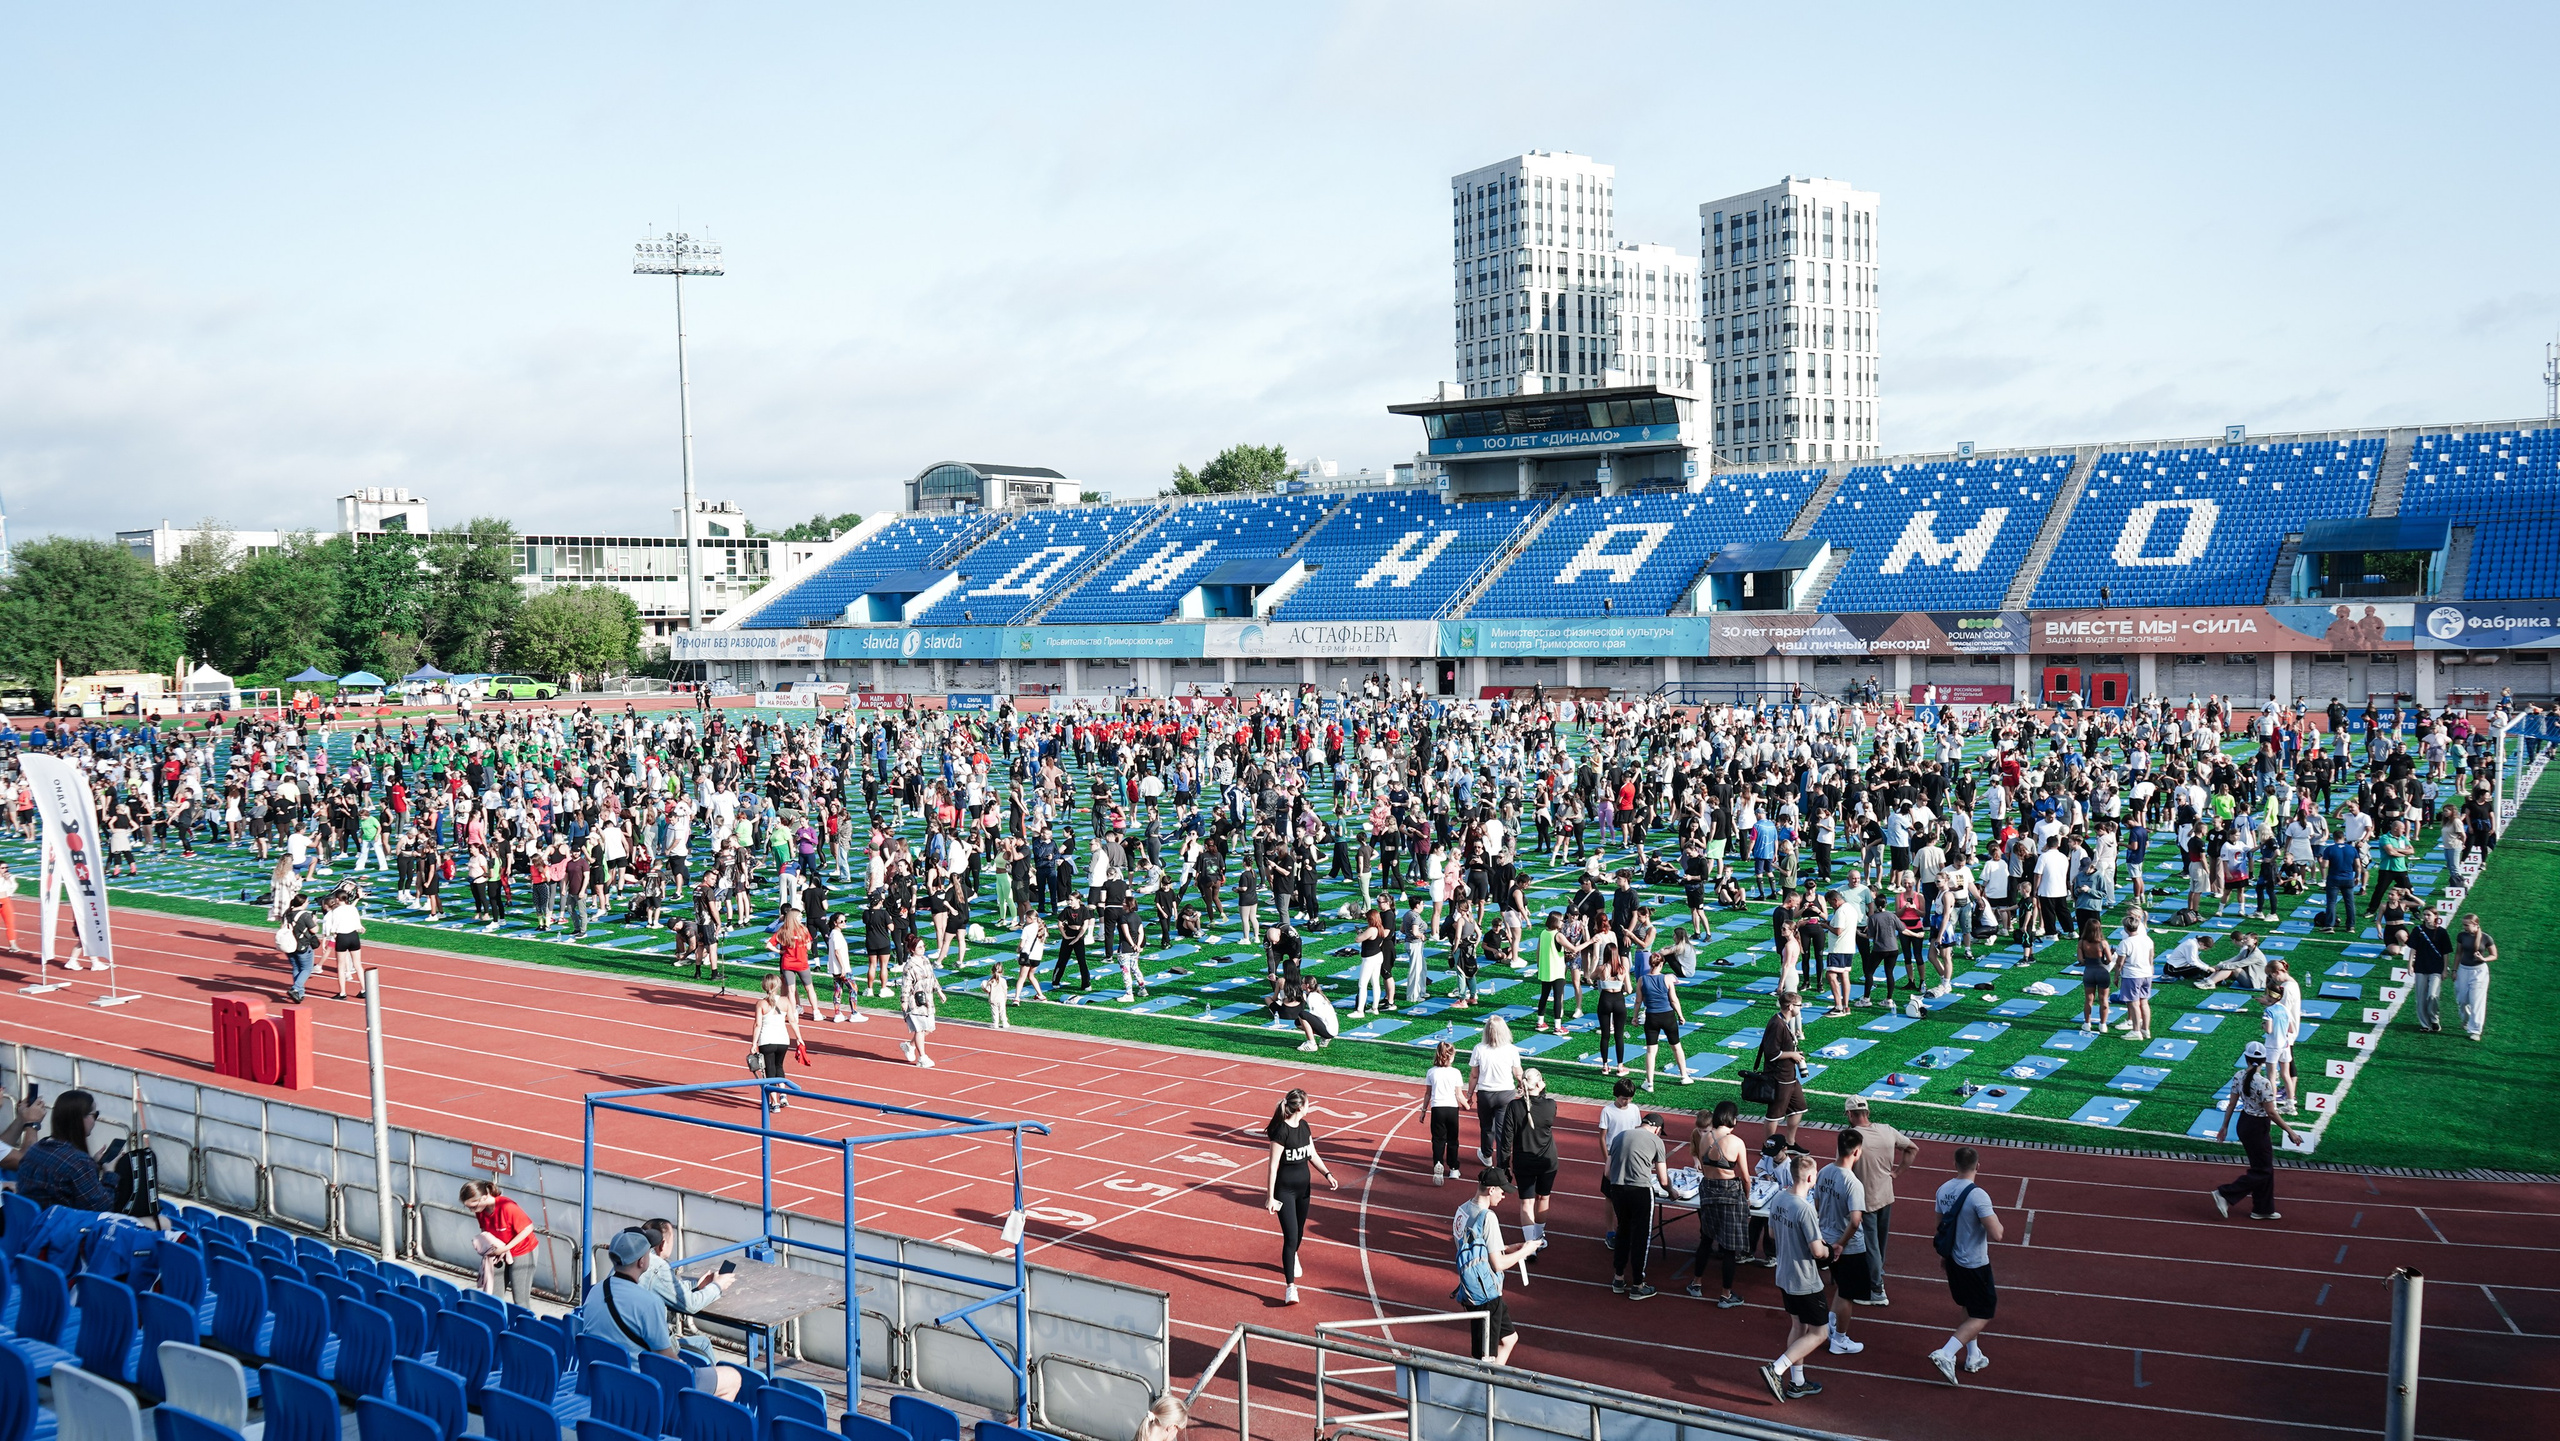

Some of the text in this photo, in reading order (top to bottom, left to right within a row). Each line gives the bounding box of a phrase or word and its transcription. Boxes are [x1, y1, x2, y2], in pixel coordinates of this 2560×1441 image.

[1482, 431, 1620, 449] 100 ЛЕТ «ДИНАМО»
[2231, 430, 2240, 439] 7
[1962, 446, 1970, 454] 6
[1688, 465, 1695, 473] 5
[1440, 479, 1447, 487] 4
[2437, 609, 2462, 624] УРСА
[2045, 621, 2133, 635] ВМЕСТЕ
[2139, 620, 2177, 634] МЫ
[2192, 618, 2258, 633] СИЛА
[2467, 615, 2551, 631] Фабрика
[1289, 626, 1398, 644] АСТАФЬЕВА
[1491, 626, 1674, 638] Министерство физической культуры
[1721, 627, 1740, 637] 30
[1742, 628, 1767, 637] лет
[1769, 627, 1836, 638] гарантии
[1948, 631, 2011, 640] POLIVAN GROUP
[713, 637, 728, 648] БЕЗ
[862, 634, 899, 649] slavda
[924, 634, 962, 649] slavda
[1046, 637, 1174, 647] Правительство Приморского края
[1499, 641, 1532, 651] спорта
[1535, 639, 1600, 650] Приморского
[1602, 640, 1626, 650] края
[1776, 638, 1930, 652] наш личный рекорд!
[2085, 636, 2115, 644] БУДЕТ
[2117, 635, 2176, 643] ВЫПОЛНЕНА!
[1314, 645, 1371, 653] ТЕРМИНАЛ
[2400, 971, 2408, 980] 7
[2388, 991, 2396, 1000] 6
[2371, 1012, 2380, 1021] 5
[2356, 1036, 2366, 1046] 4
[2335, 1064, 2345, 1075] 3
[2316, 1097, 2326, 1109] 2
